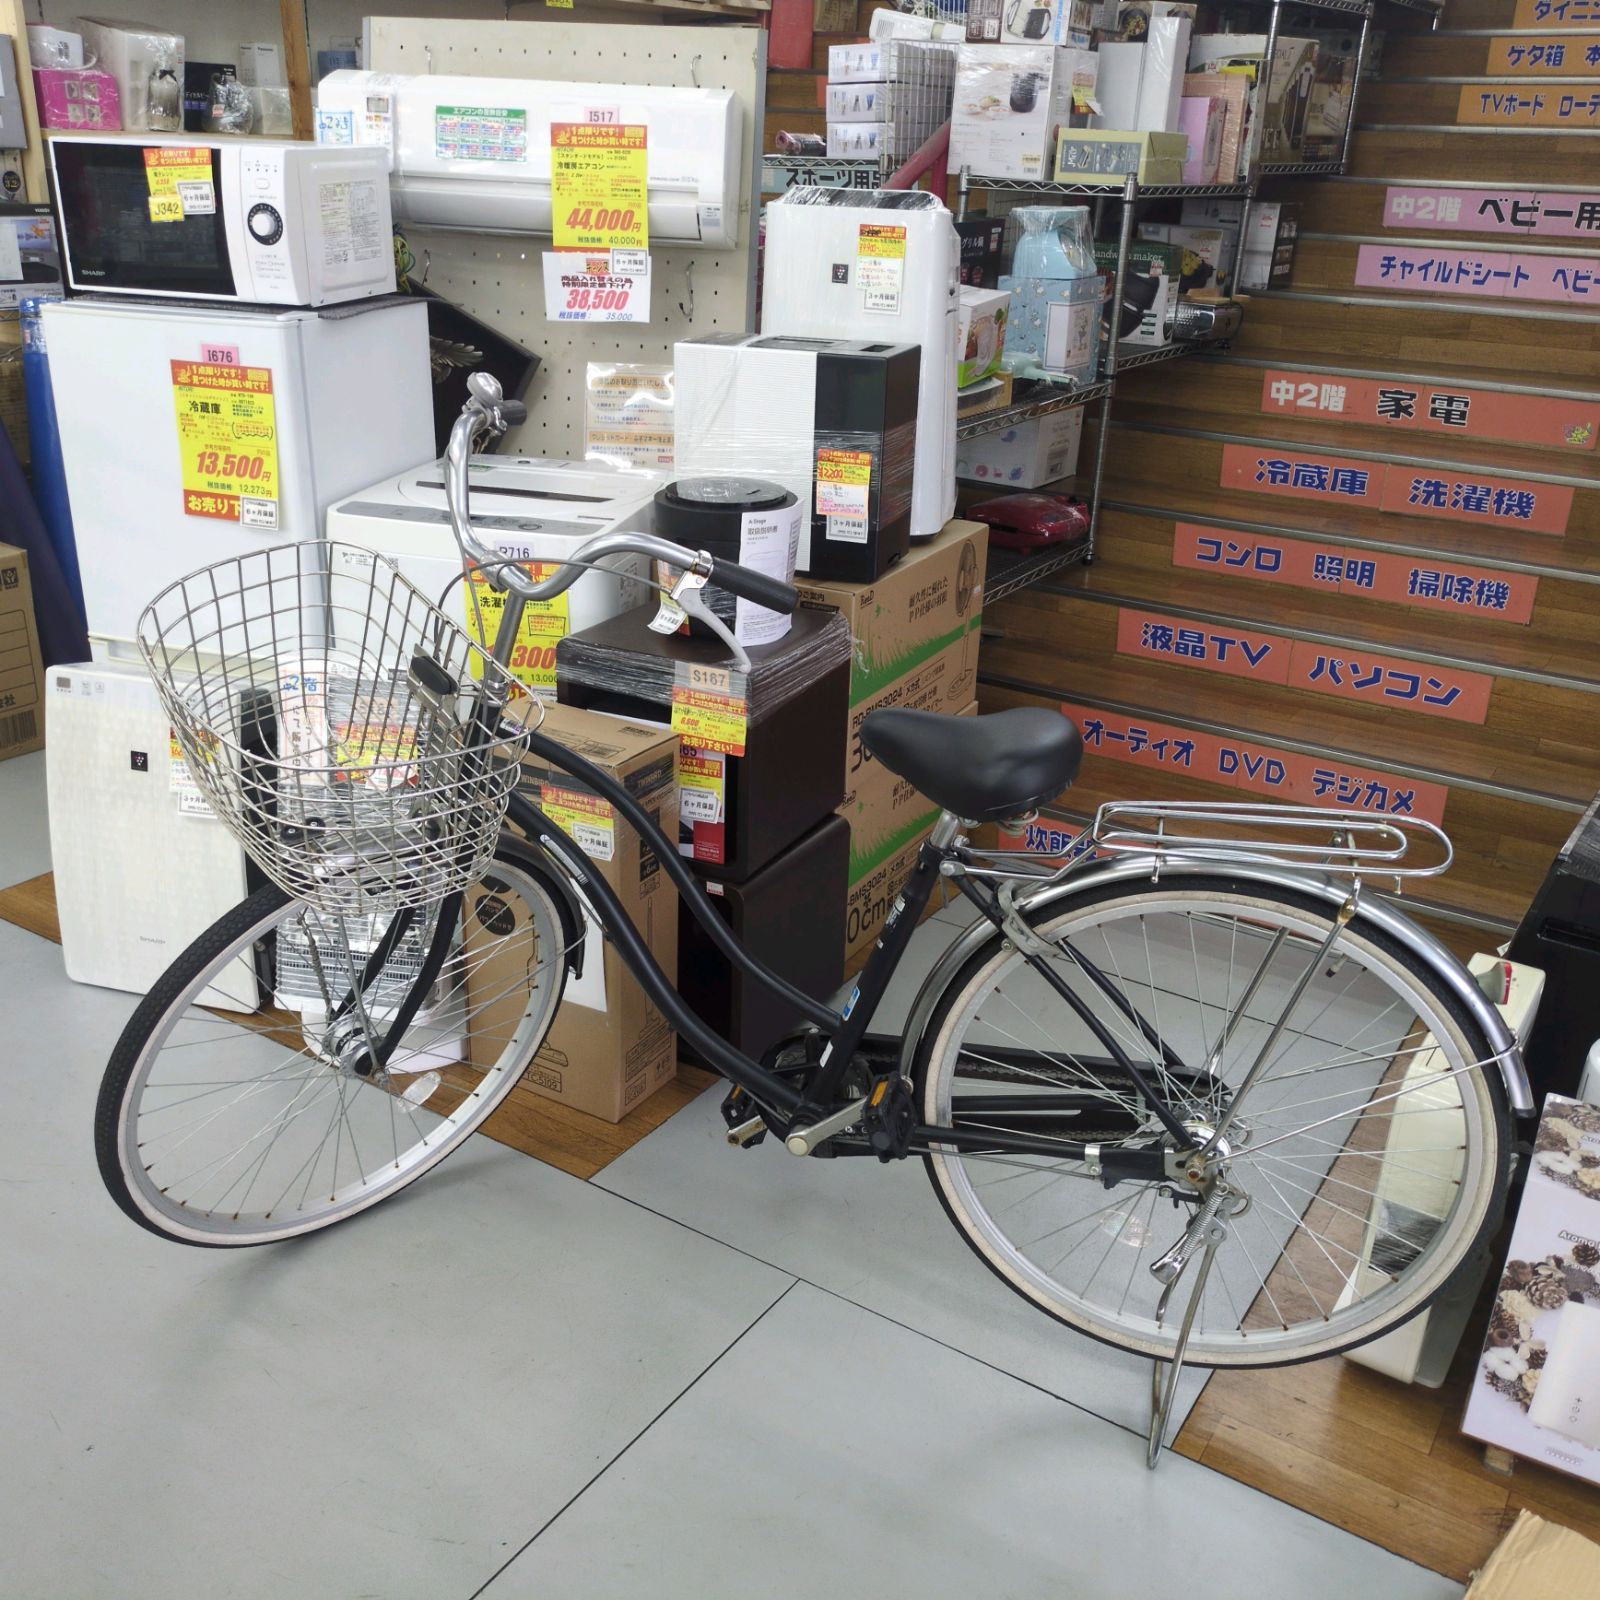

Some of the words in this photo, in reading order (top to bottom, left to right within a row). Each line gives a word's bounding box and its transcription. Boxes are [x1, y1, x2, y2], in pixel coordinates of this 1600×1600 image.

[1507, 44, 1566, 67] ゲタ箱
[1480, 93, 1544, 116] TVボード
[588, 111, 613, 122] I517
[556, 162, 605, 171] 冷暖房エアコン
[154, 203, 180, 215] J342
[1391, 194, 1463, 224] 中2階
[1478, 197, 1600, 231] ベビー用
[1133, 252, 1163, 264] maker
[561, 275, 633, 284] 商品入れ替えの為
[1380, 255, 1530, 288] チャイルドシート
[1552, 267, 1600, 294] ベビ
[566, 288, 629, 311] 38,500
[207, 349, 233, 363] I676
[188, 400, 222, 415] 冷蔵庫
[1270, 379, 1347, 413] 中2階
[1376, 388, 1471, 427] 家電
[1255, 459, 1369, 496] 冷蔵庫
[1408, 479, 1537, 520] 洗濯機
[833, 519, 863, 528] 3ヶ月保証
[1196, 537, 1282, 573] コンロ
[1313, 553, 1377, 588] 照明
[1408, 568, 1510, 610] 掃除機
[1141, 622, 1272, 667] 液晶TV
[1308, 656, 1462, 707] パソコン
[682, 736, 733, 753] お売り下さい!
[1082, 718, 1195, 767] オーディオ
[1218, 749, 1287, 785] DVD
[1311, 768, 1416, 814] デジカメ
[521, 775, 551, 786] WINBIRD
[684, 801, 714, 811] 6ヶ月保証
[577, 834, 608, 848] 3ヶ月保証
[1558, 1230, 1595, 1248] Aroma
